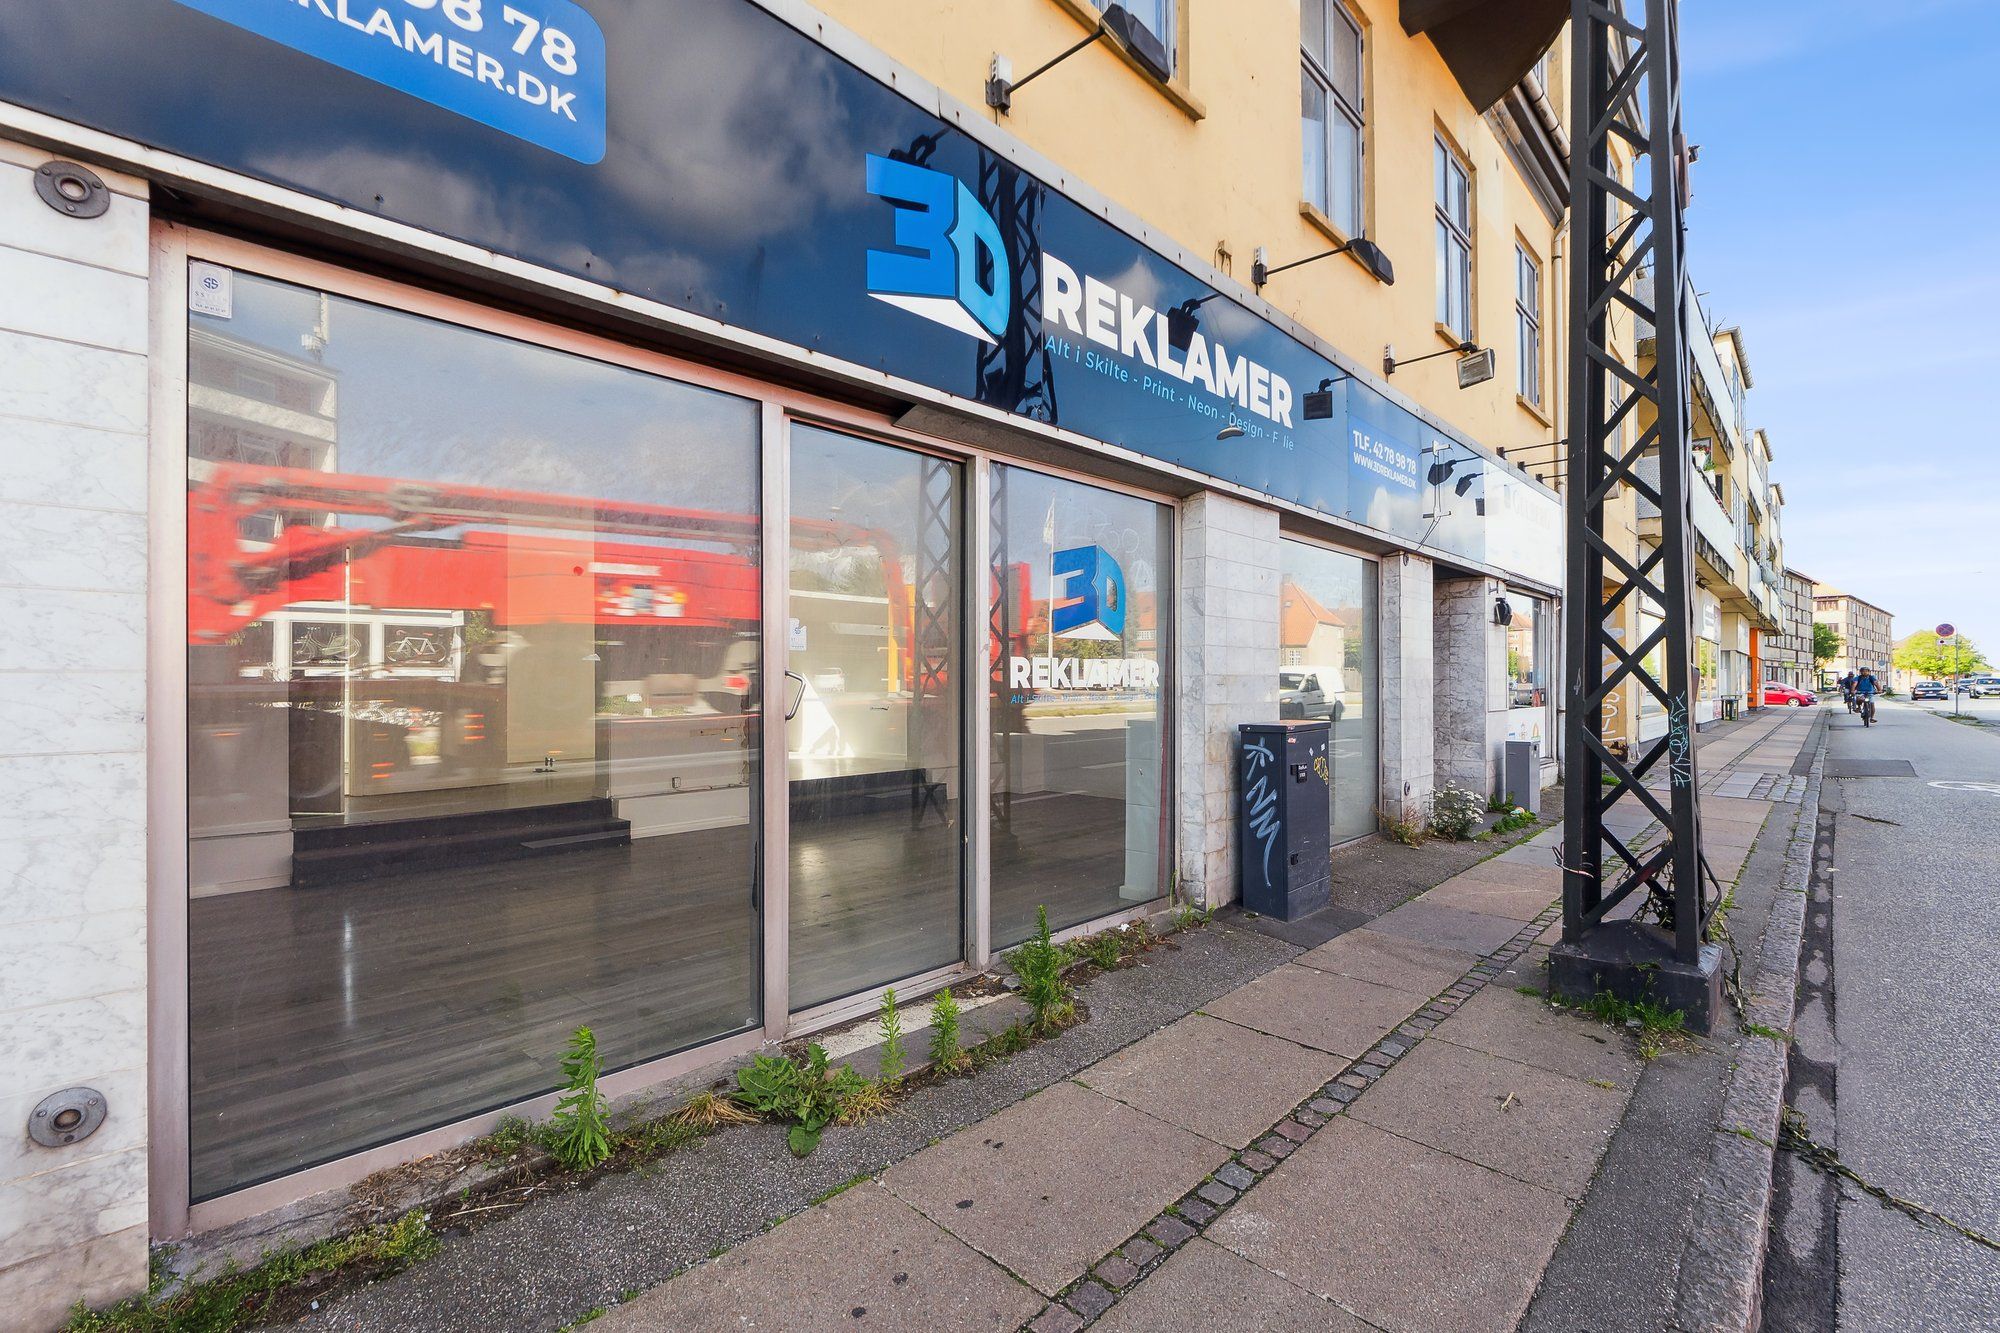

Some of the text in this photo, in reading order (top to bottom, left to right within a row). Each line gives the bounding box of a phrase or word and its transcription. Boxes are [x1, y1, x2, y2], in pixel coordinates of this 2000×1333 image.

[503, 5, 578, 76] 78
[865, 152, 1011, 336] 3D
[1042, 251, 1293, 429] REKLAMER
[1044, 335, 1070, 359] Alt
[1075, 347, 1081, 363] i
[1085, 352, 1129, 383] Skilte
[1143, 375, 1175, 402] Print
[1188, 395, 1218, 419] Neon
[1229, 412, 1263, 440] Design
[1352, 429, 1416, 475] TLF. 42 78 98 78
[1053, 544, 1126, 636] 3D
[1010, 656, 1160, 689] REKLAMER
